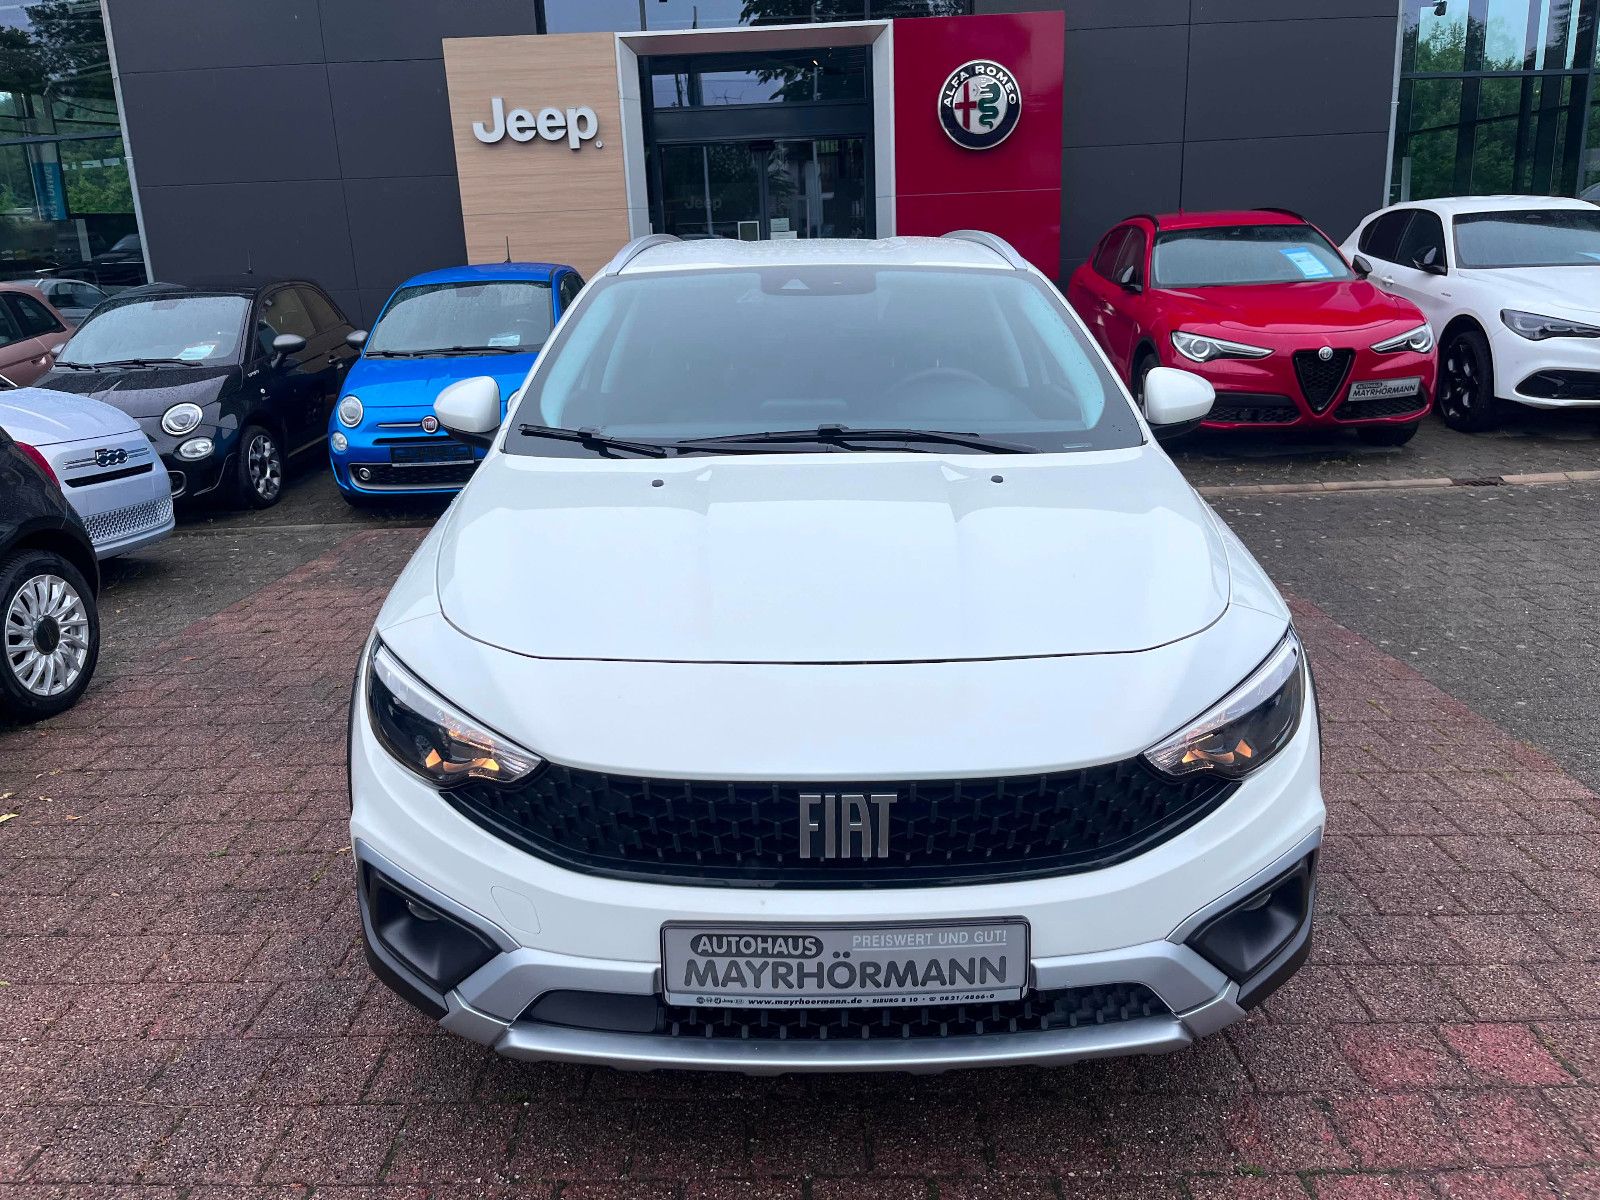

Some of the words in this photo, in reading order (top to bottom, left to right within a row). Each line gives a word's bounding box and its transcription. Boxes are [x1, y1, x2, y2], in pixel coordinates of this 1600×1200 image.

[943, 71, 969, 108] ALFA
[975, 65, 1017, 105] ROMEO
[472, 96, 598, 150] Jeep
[1352, 384, 1416, 397] MAYRHÖRMANN
[95, 448, 128, 468] 500
[800, 794, 898, 859] FIAT
[697, 936, 817, 956] AUTOHAUS
[852, 933, 933, 948] PREISWERT
[938, 932, 969, 944] UND
[973, 930, 1007, 943] GUT!
[684, 951, 1007, 990] MAYRHÖRMANN
[748, 997, 862, 1006] www.mayrhoermann.de
